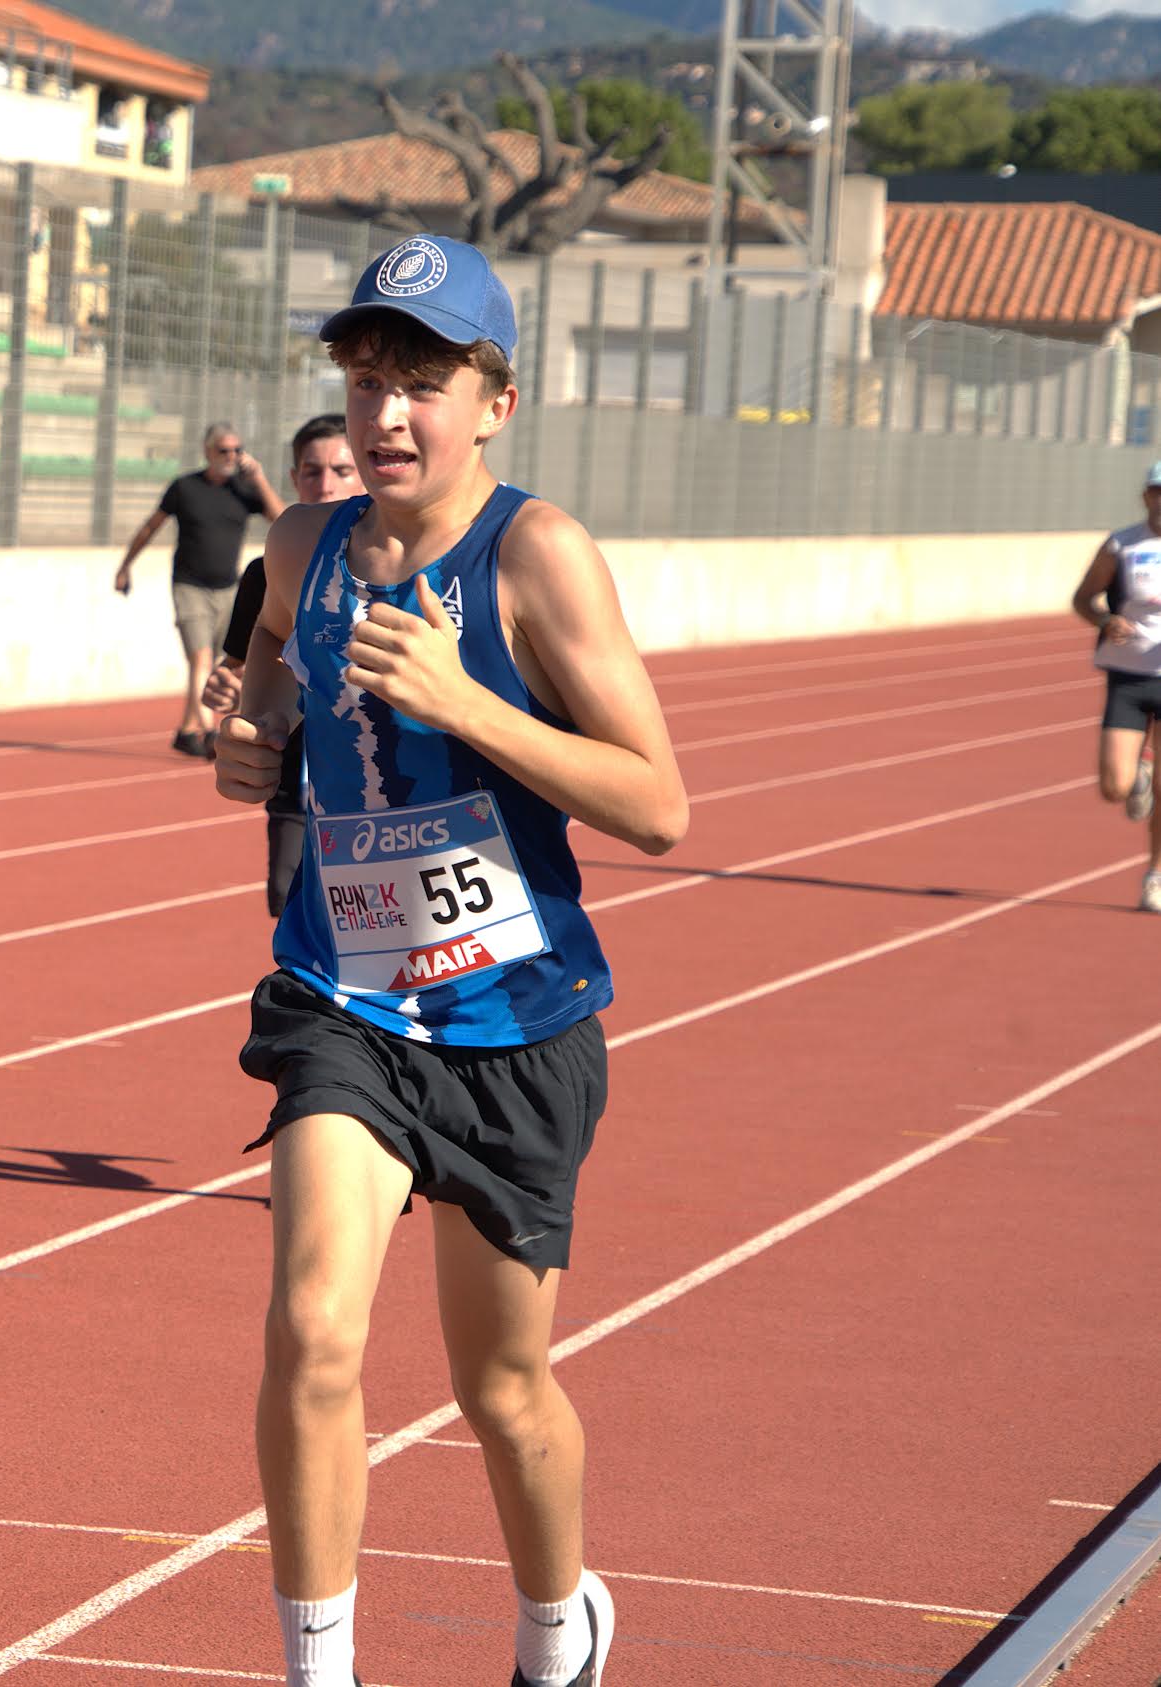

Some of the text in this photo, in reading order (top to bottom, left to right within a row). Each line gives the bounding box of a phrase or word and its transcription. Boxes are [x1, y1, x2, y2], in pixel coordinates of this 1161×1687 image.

[419, 857, 494, 925] 55
[336, 906, 408, 932] CHALLENGE
[400, 939, 485, 983] MAIF
